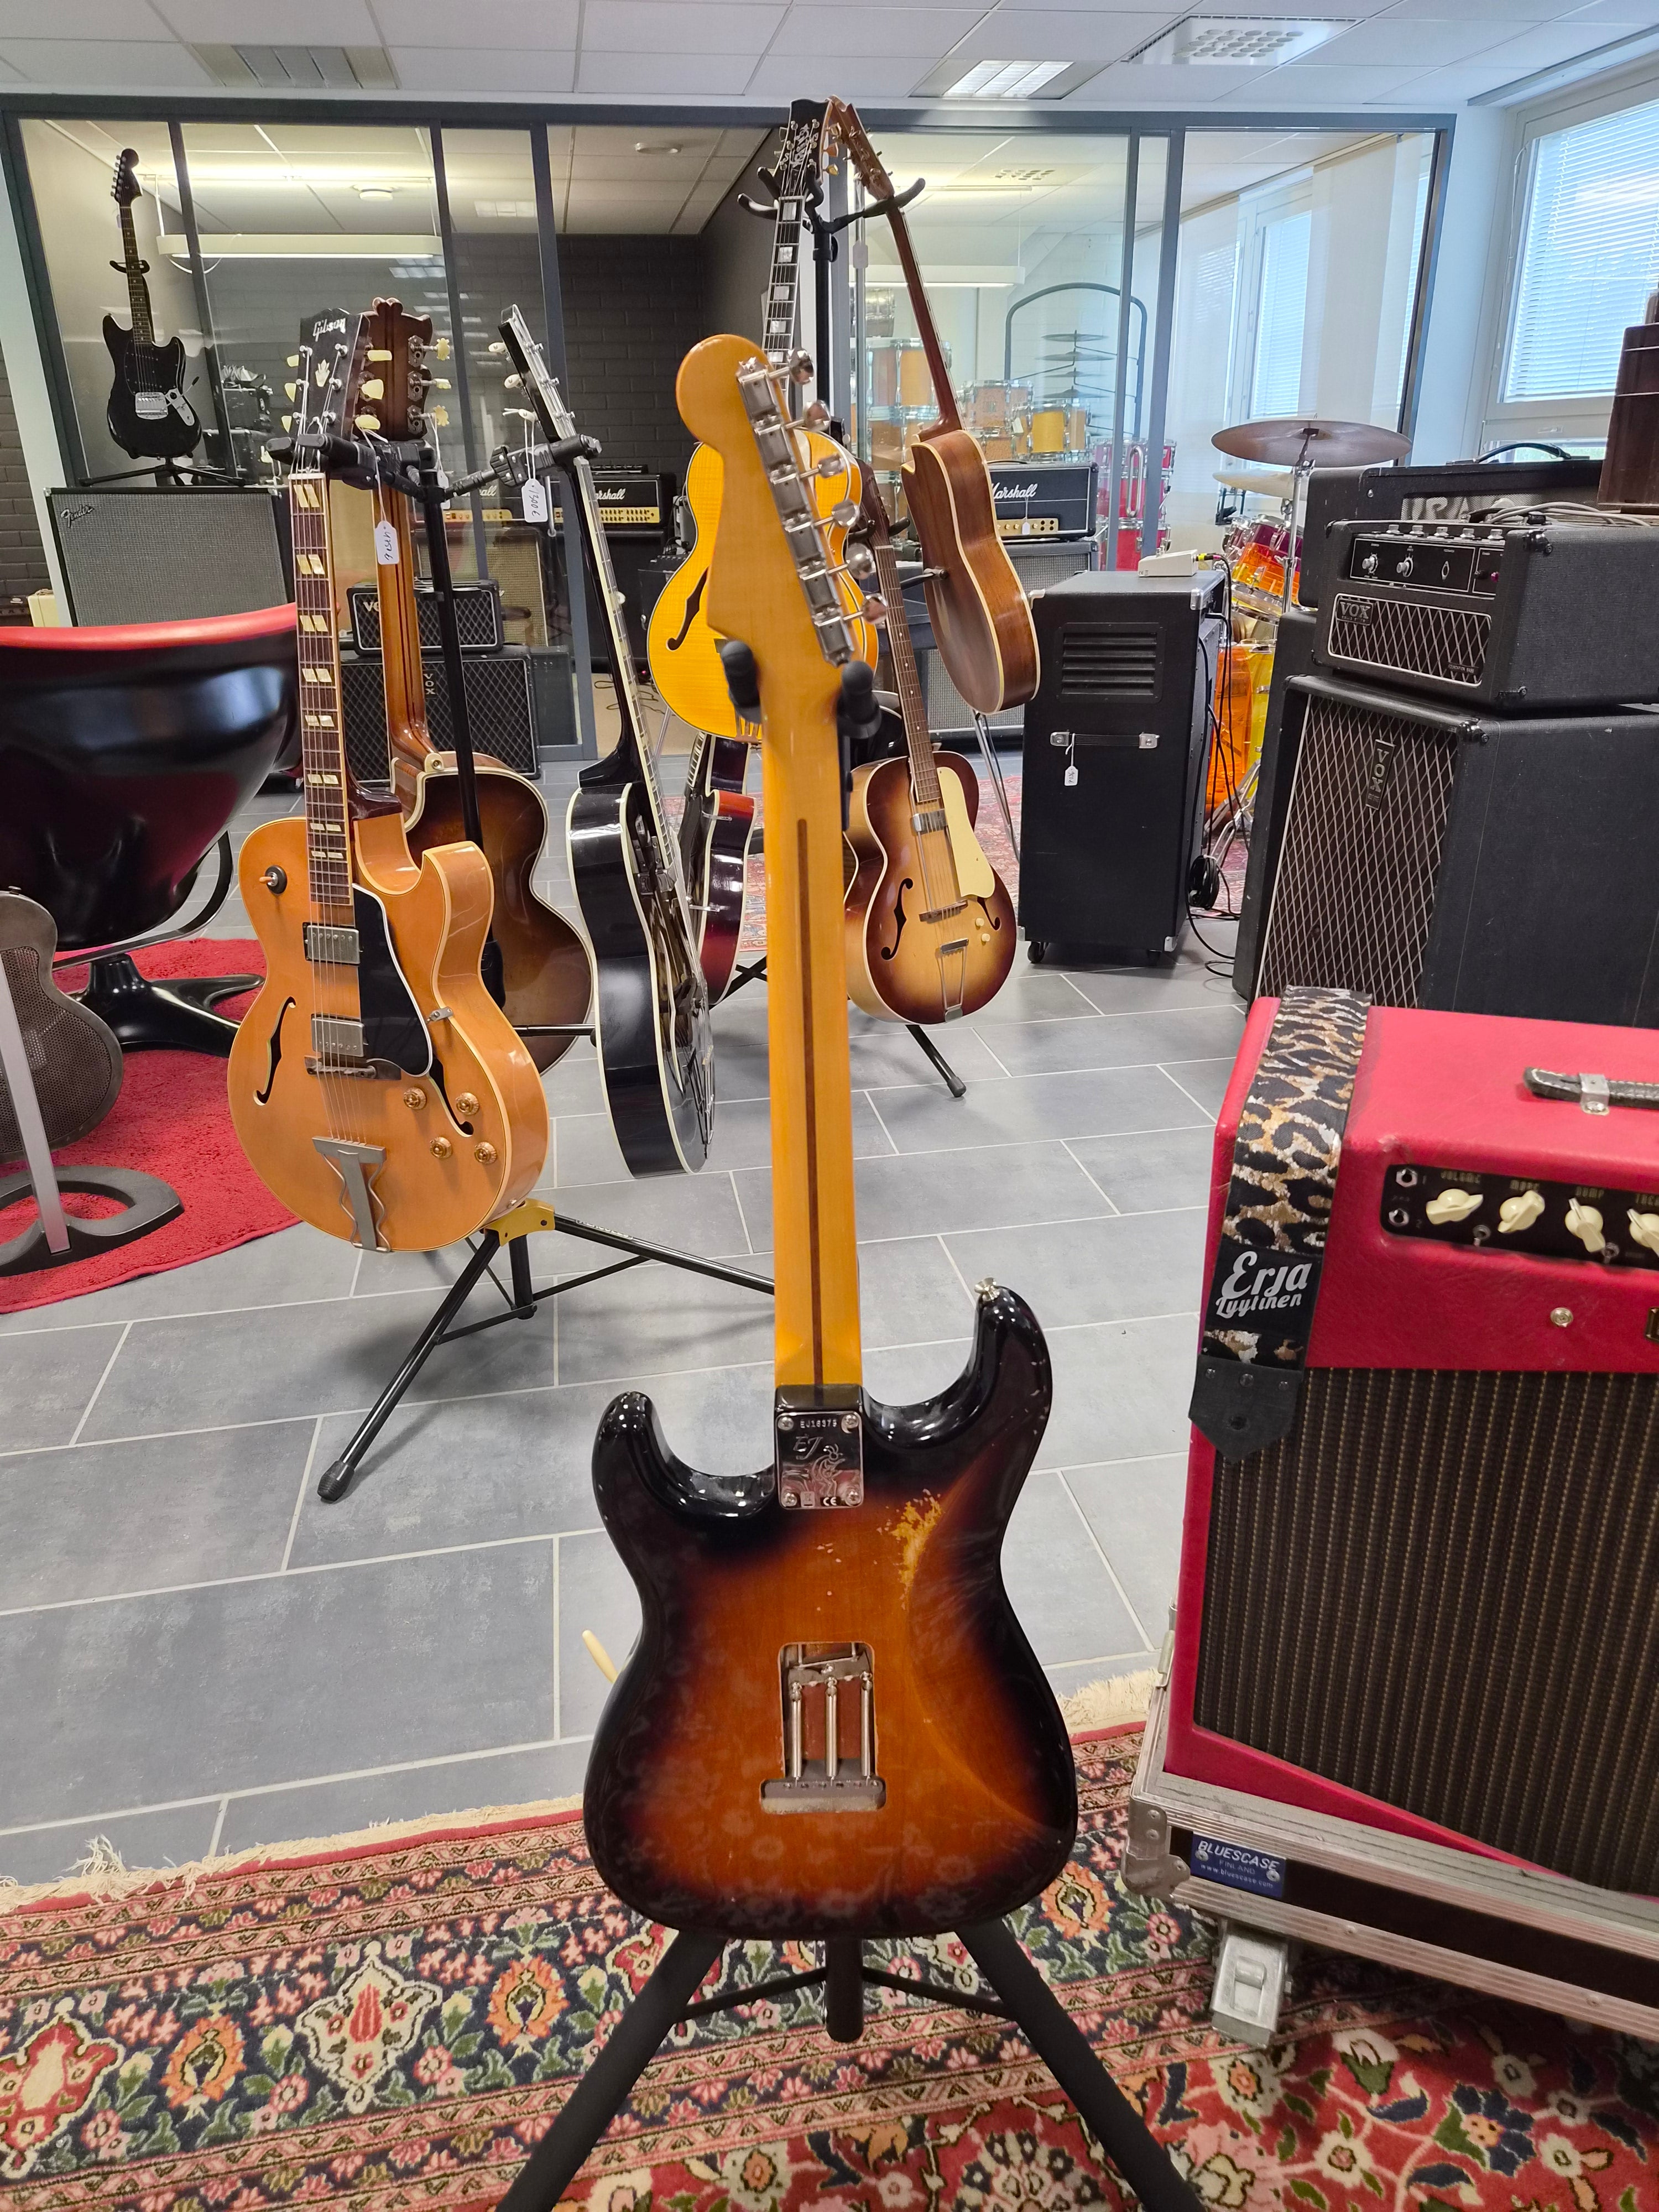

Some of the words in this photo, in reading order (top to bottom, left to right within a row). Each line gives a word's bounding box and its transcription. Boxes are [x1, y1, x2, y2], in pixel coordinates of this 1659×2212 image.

[312, 318, 346, 342] Gibson
[60, 504, 93, 528] Fender
[1340, 602, 1371, 619] VOX
[423, 673, 436, 695] VOX
[1370, 748, 1390, 793] VOX
[1221, 1250, 1313, 1300] Erja
[1215, 1293, 1302, 1319] Lyytinen
[1197, 1840, 1281, 1870] BLUESCASE
[1219, 1859, 1256, 1875] FINLAND
[1200, 1864, 1274, 1888] www.bluescase.com
